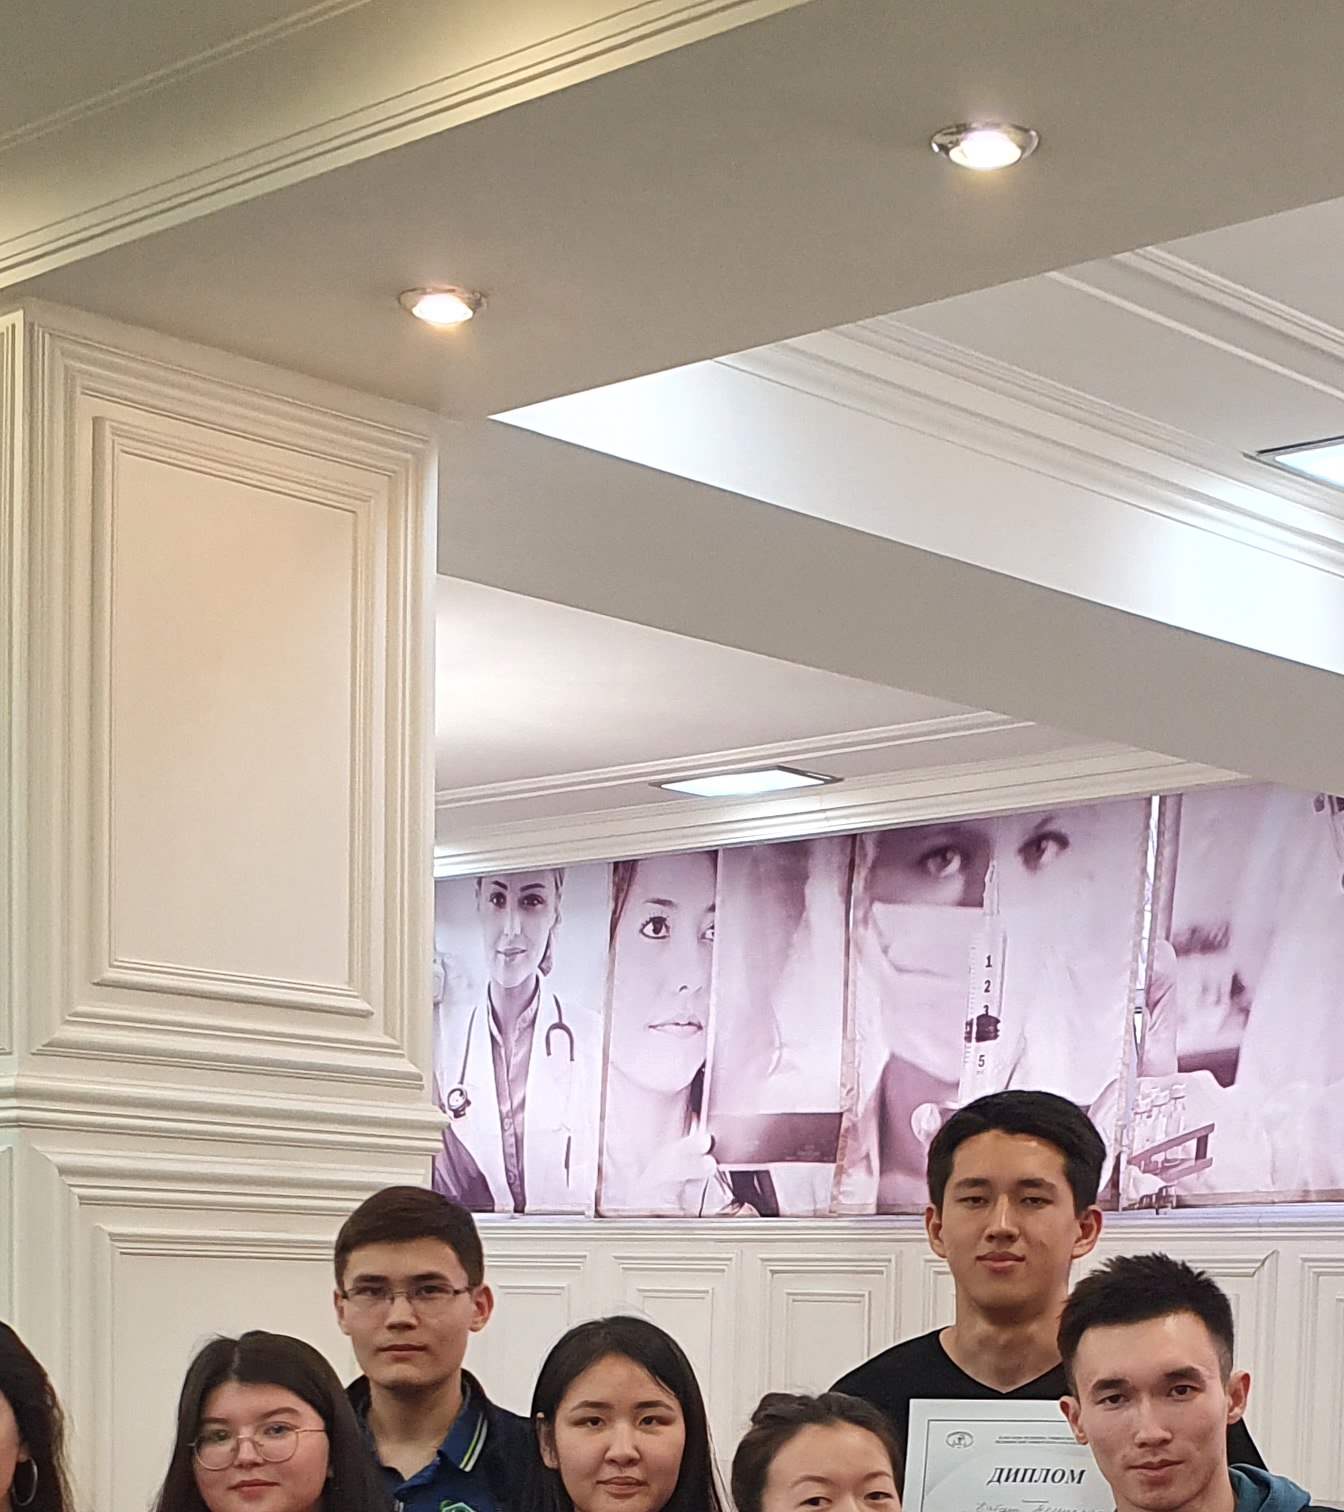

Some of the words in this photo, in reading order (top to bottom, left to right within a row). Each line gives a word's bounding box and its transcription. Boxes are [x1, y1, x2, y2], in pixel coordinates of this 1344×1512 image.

[985, 954, 992, 968] 1
[984, 979, 991, 993] 2
[978, 1054, 986, 1067] 5
[986, 1466, 1087, 1486] ДИПЛОМ
